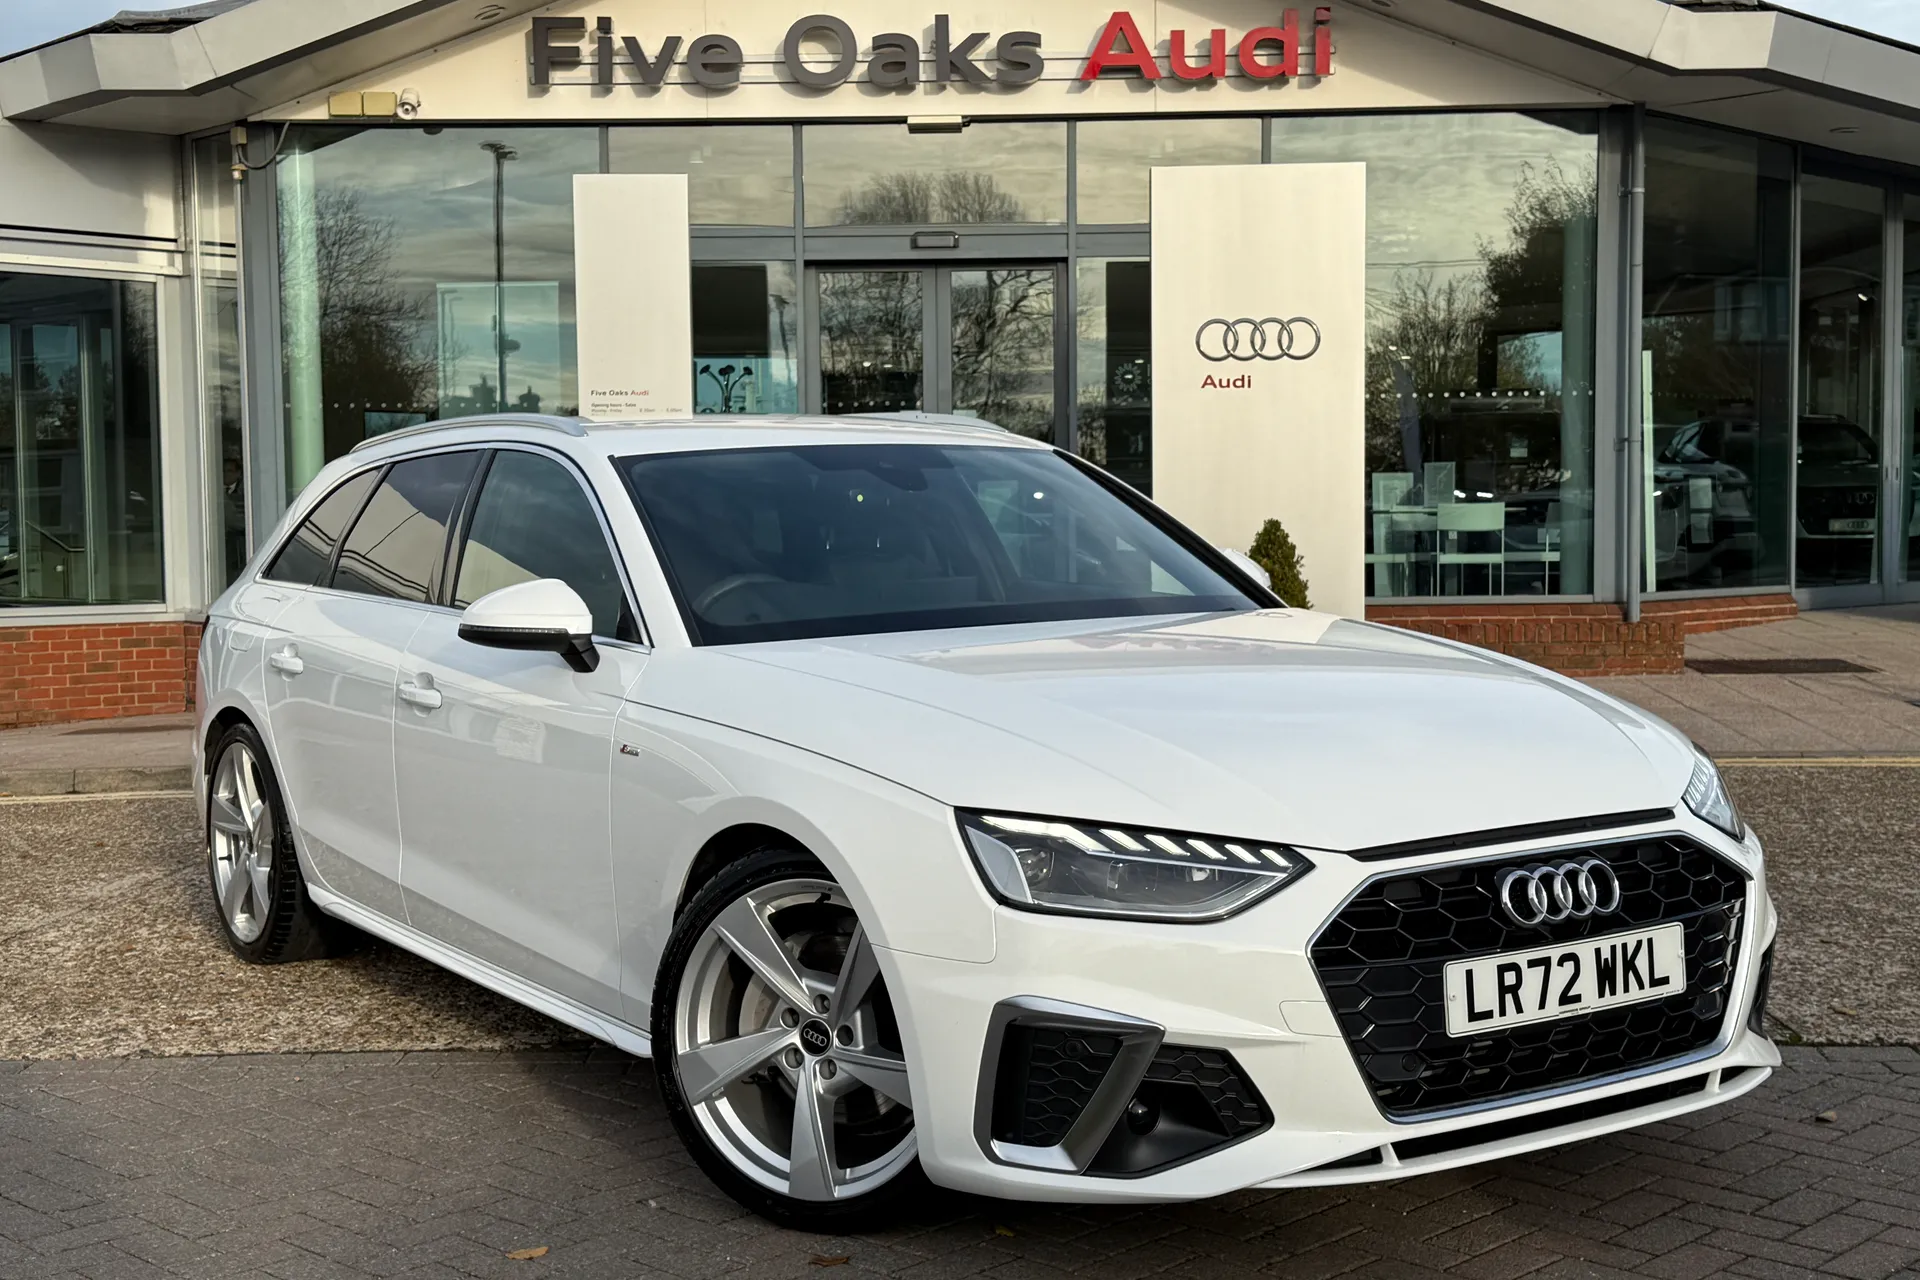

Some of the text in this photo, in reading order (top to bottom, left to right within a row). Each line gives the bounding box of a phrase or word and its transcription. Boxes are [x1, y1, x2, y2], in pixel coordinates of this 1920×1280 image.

[531, 6, 1332, 90] Five Oaks Audi
[1201, 374, 1251, 389] Audi
[1465, 937, 1670, 1023] LR72 WKL
